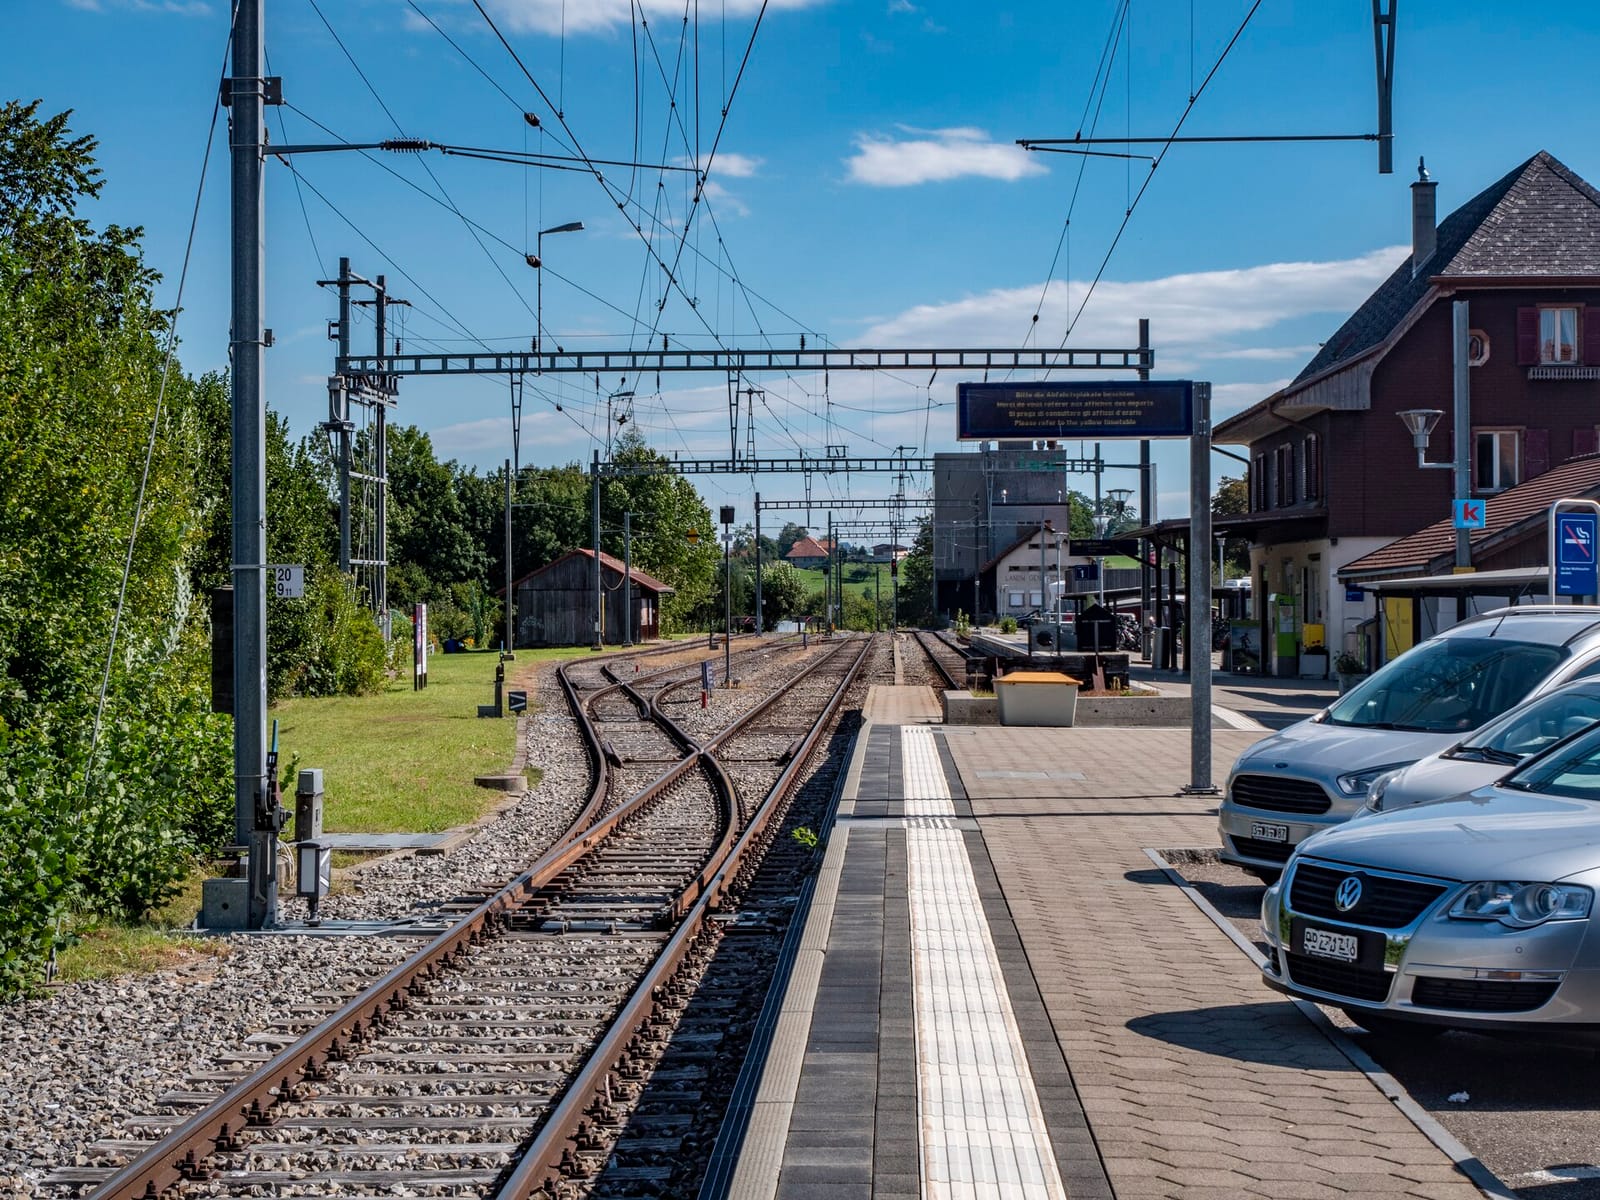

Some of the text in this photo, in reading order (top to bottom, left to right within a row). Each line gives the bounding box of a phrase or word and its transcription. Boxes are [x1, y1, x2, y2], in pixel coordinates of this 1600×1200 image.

[278, 568, 291, 581] 20
[277, 583, 292, 596] 9 11
